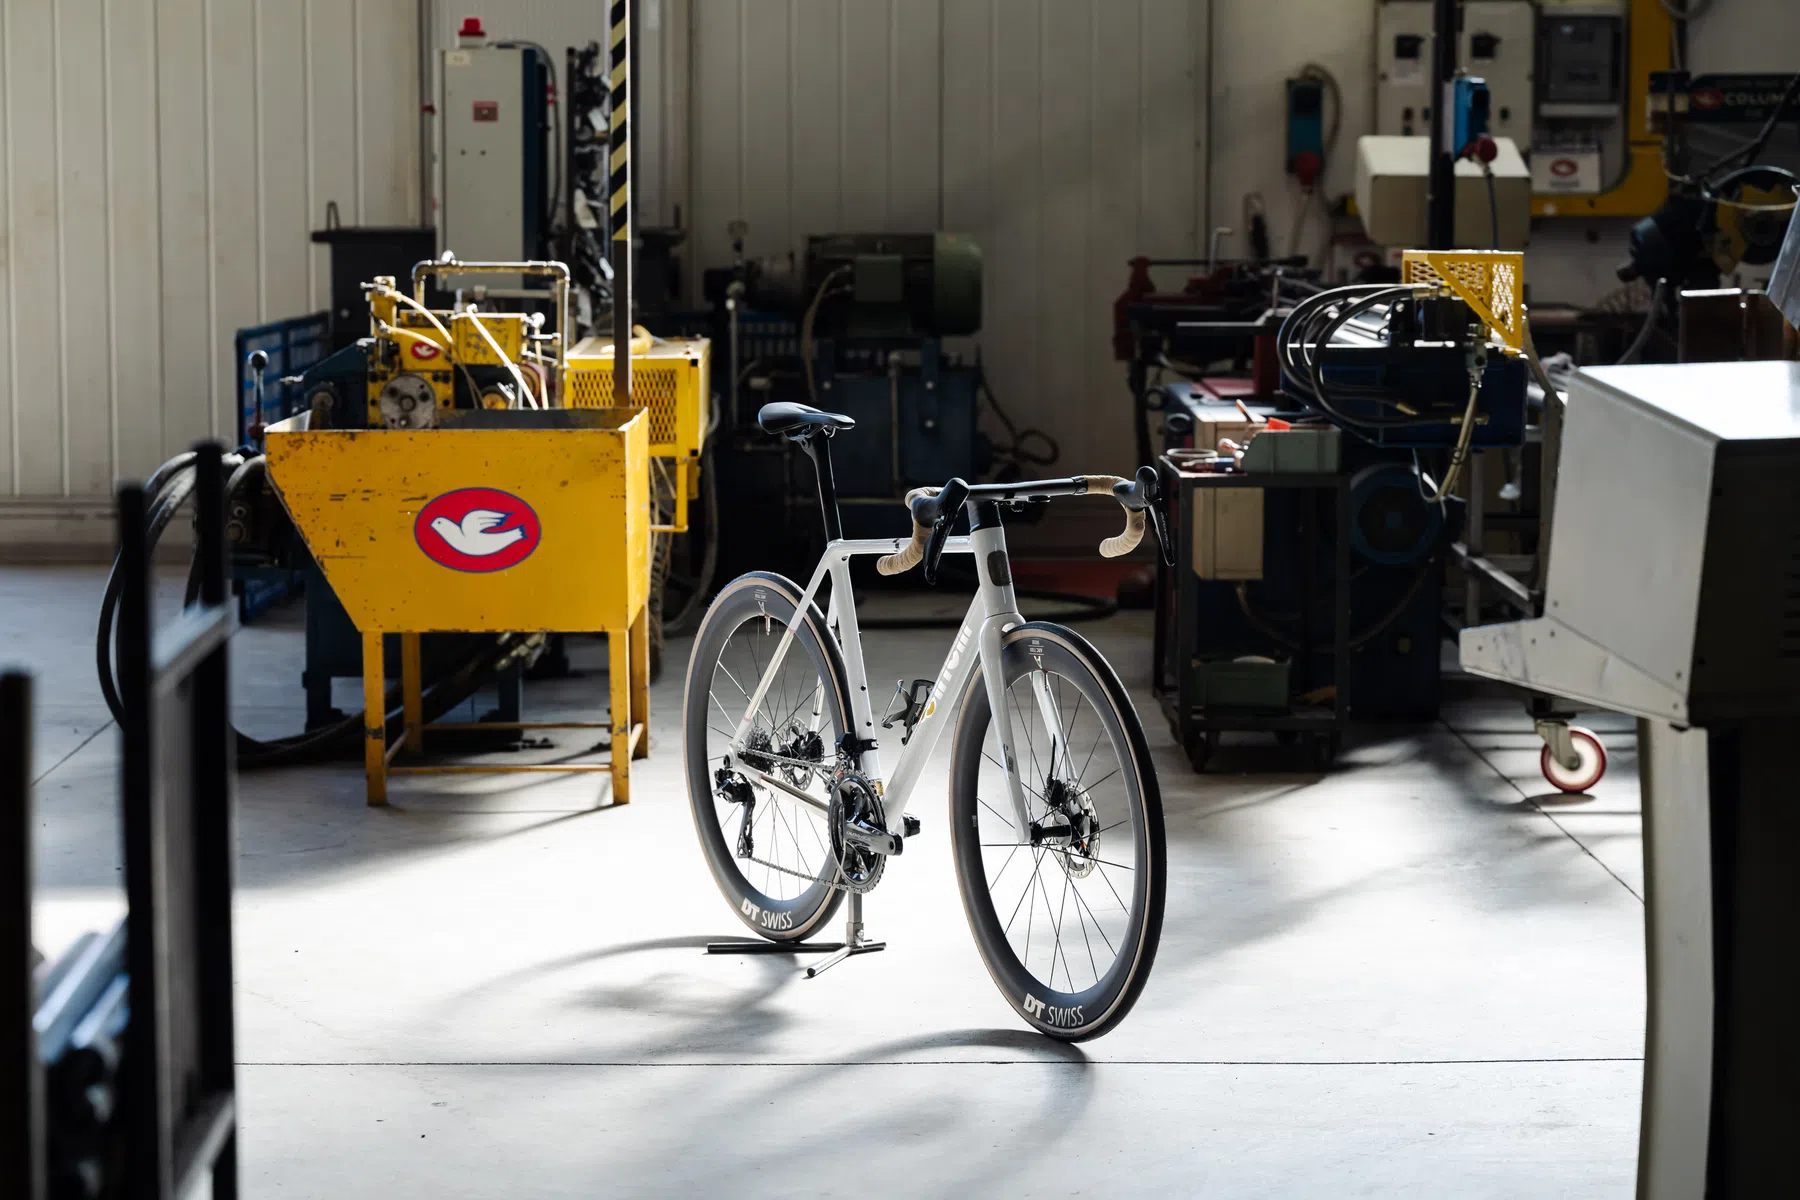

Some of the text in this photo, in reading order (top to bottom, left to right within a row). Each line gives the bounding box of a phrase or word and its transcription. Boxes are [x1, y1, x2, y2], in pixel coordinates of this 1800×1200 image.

[741, 897, 793, 929] DT SWISS
[1023, 993, 1084, 1027] DT SWISS
